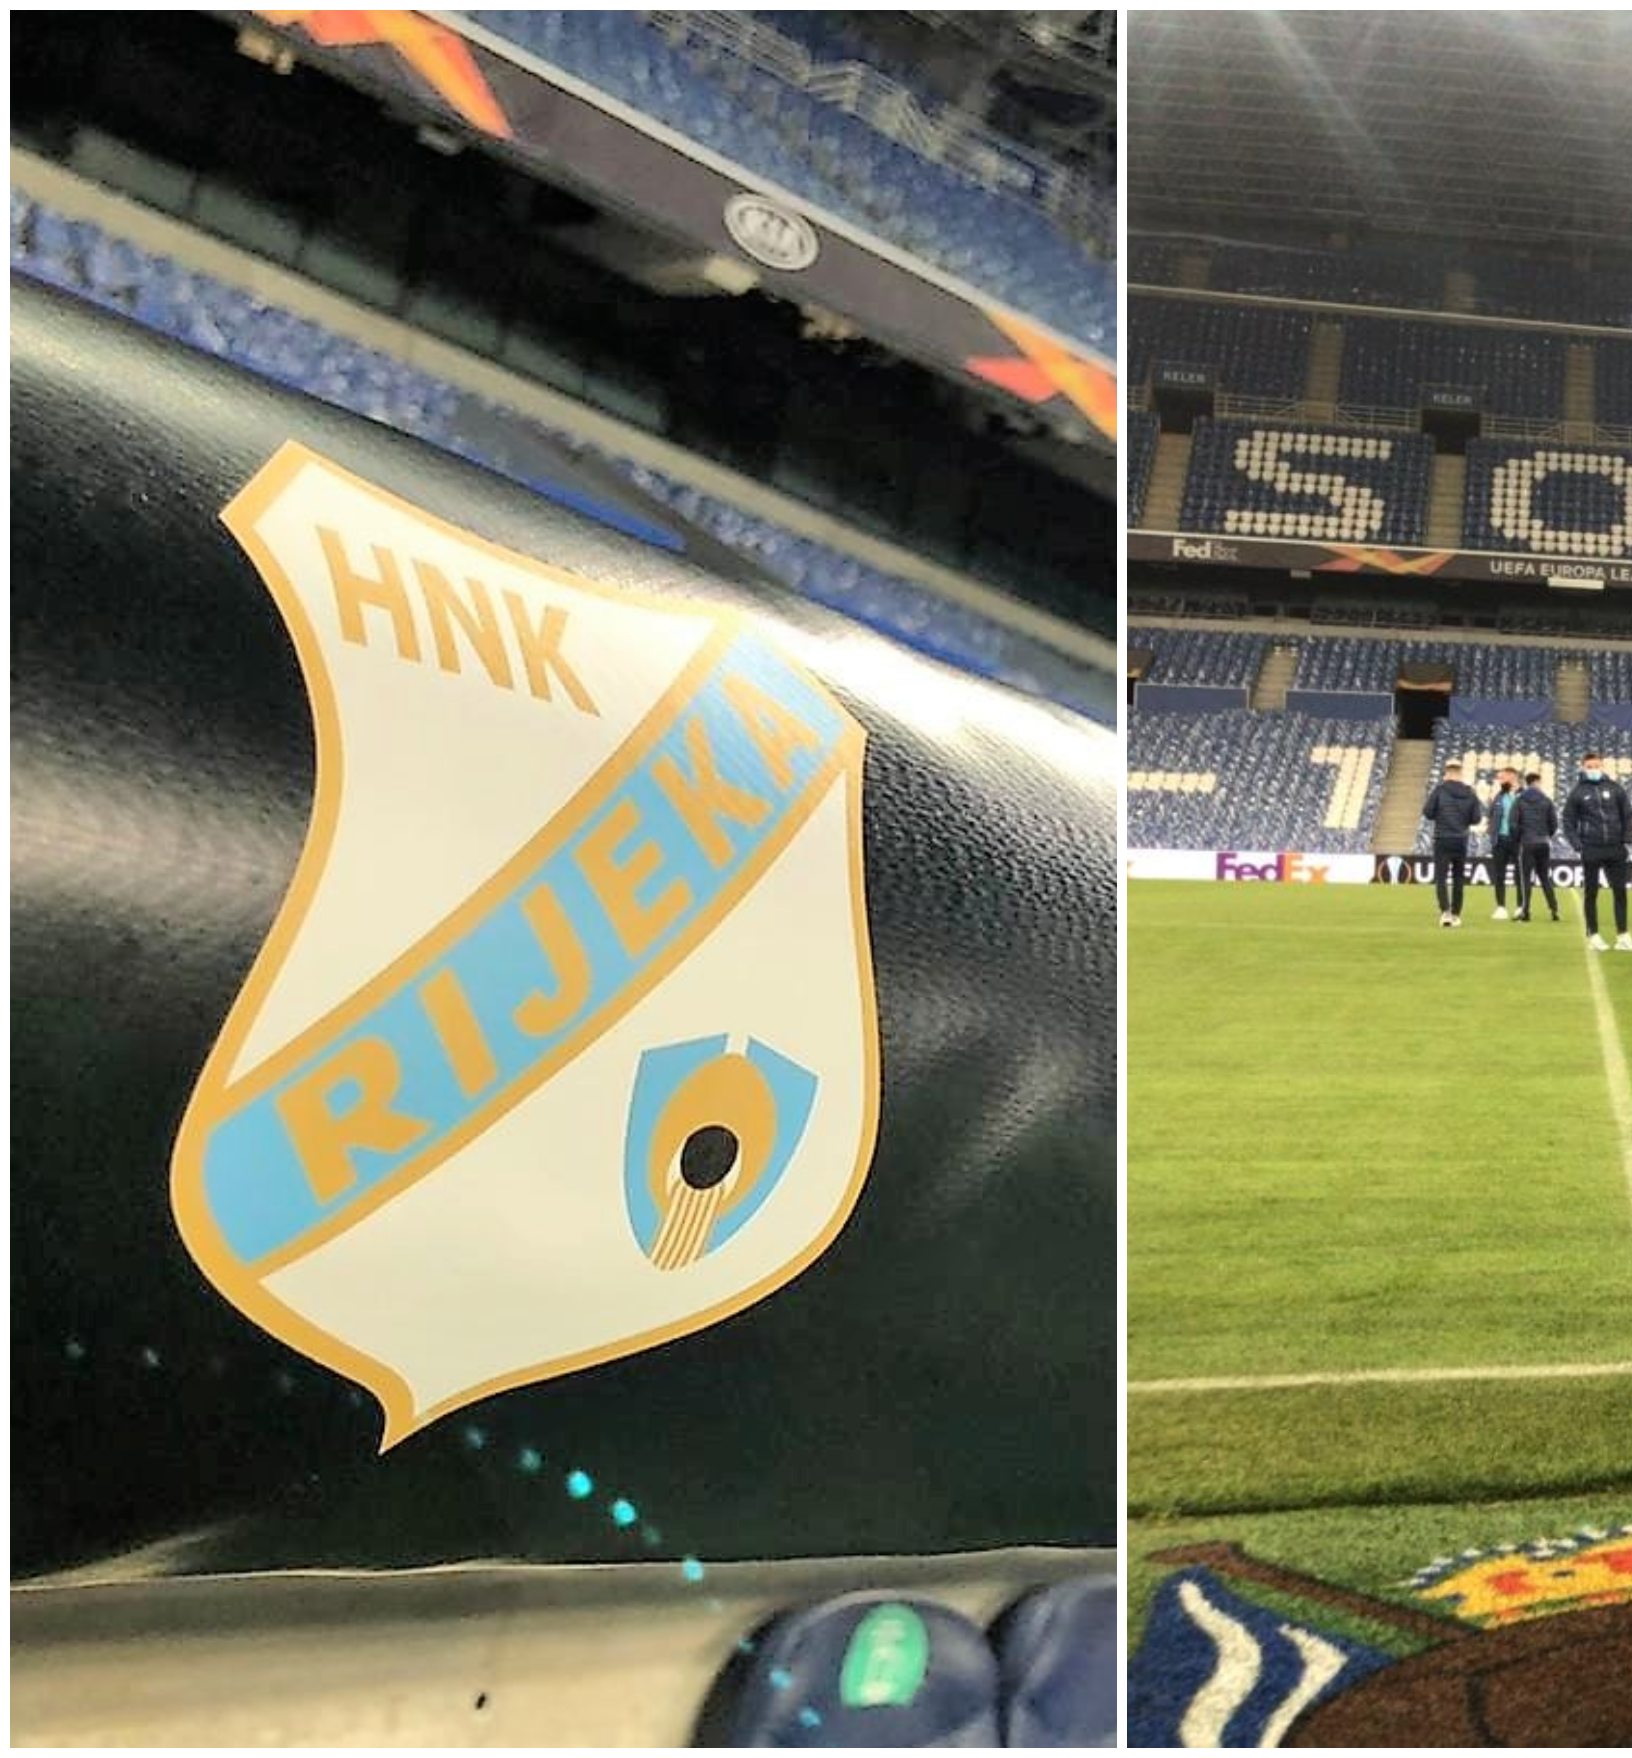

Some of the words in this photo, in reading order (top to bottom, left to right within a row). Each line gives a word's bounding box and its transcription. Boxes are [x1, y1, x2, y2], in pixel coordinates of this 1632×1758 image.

[1172, 538, 1238, 561] FedEx
[1489, 560, 1535, 576] UEFA
[1540, 563, 1606, 579] EUROPA
[315, 525, 602, 719] HNK
[1216, 852, 1329, 884] FedEx
[1414, 862, 1490, 885] UFA
[273, 671, 822, 1206] RIJEKA
